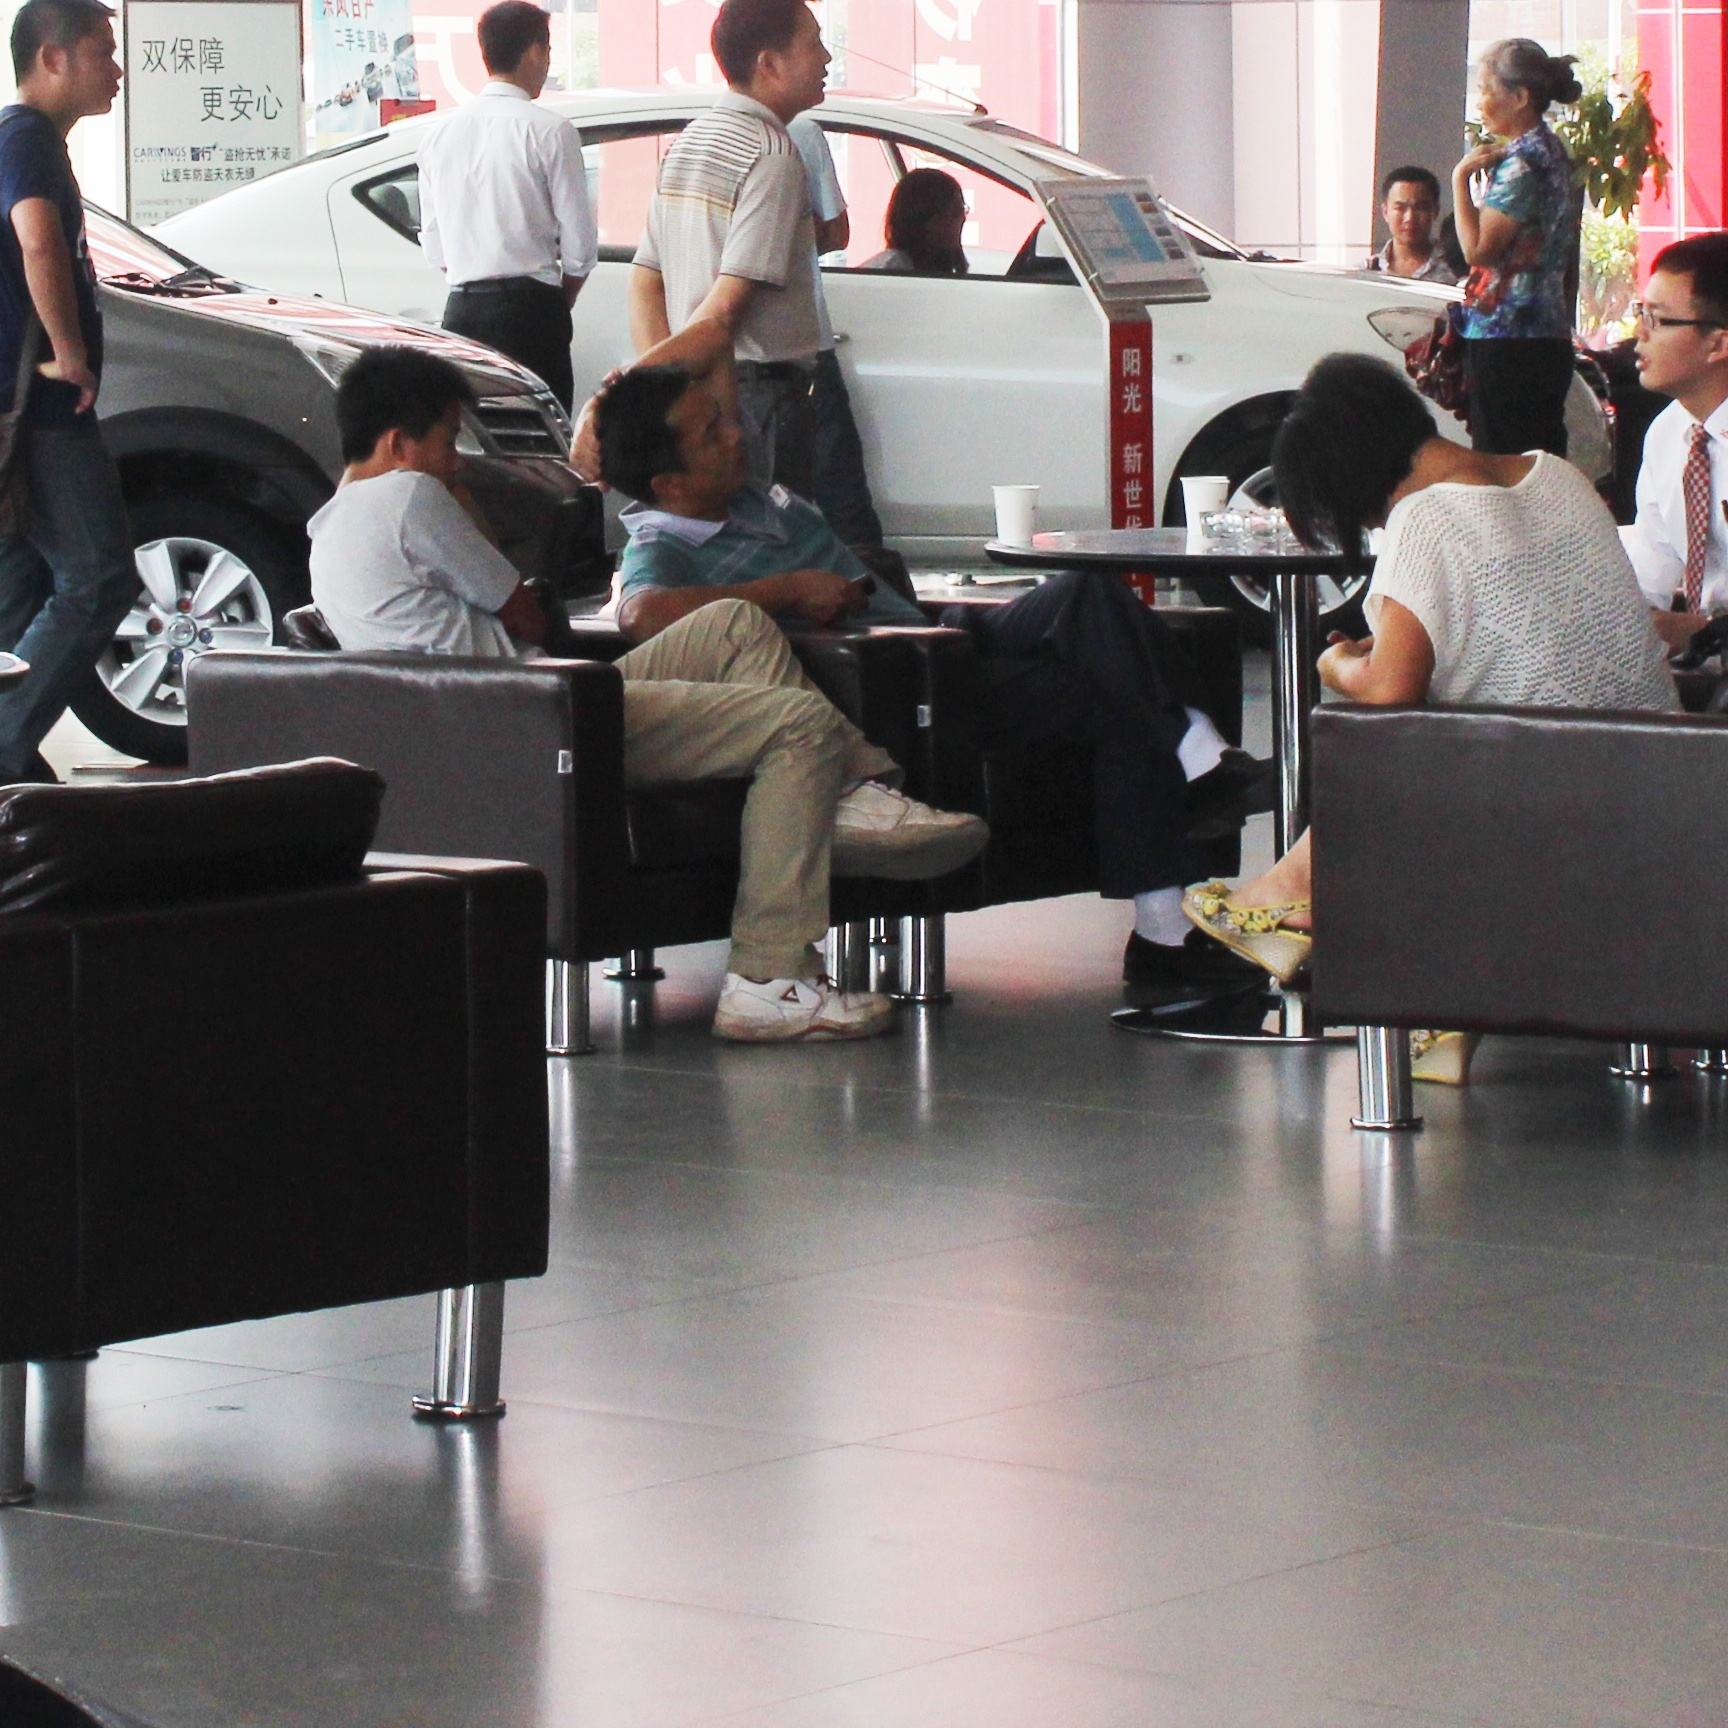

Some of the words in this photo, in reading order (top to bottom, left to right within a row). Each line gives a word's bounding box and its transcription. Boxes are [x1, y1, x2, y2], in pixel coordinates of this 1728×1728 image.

[141, 36, 226, 75] 双保障
[200, 84, 284, 123] 更安心
[133, 146, 187, 158] CARWINGS
[1122, 347, 1142, 415] 阳光
